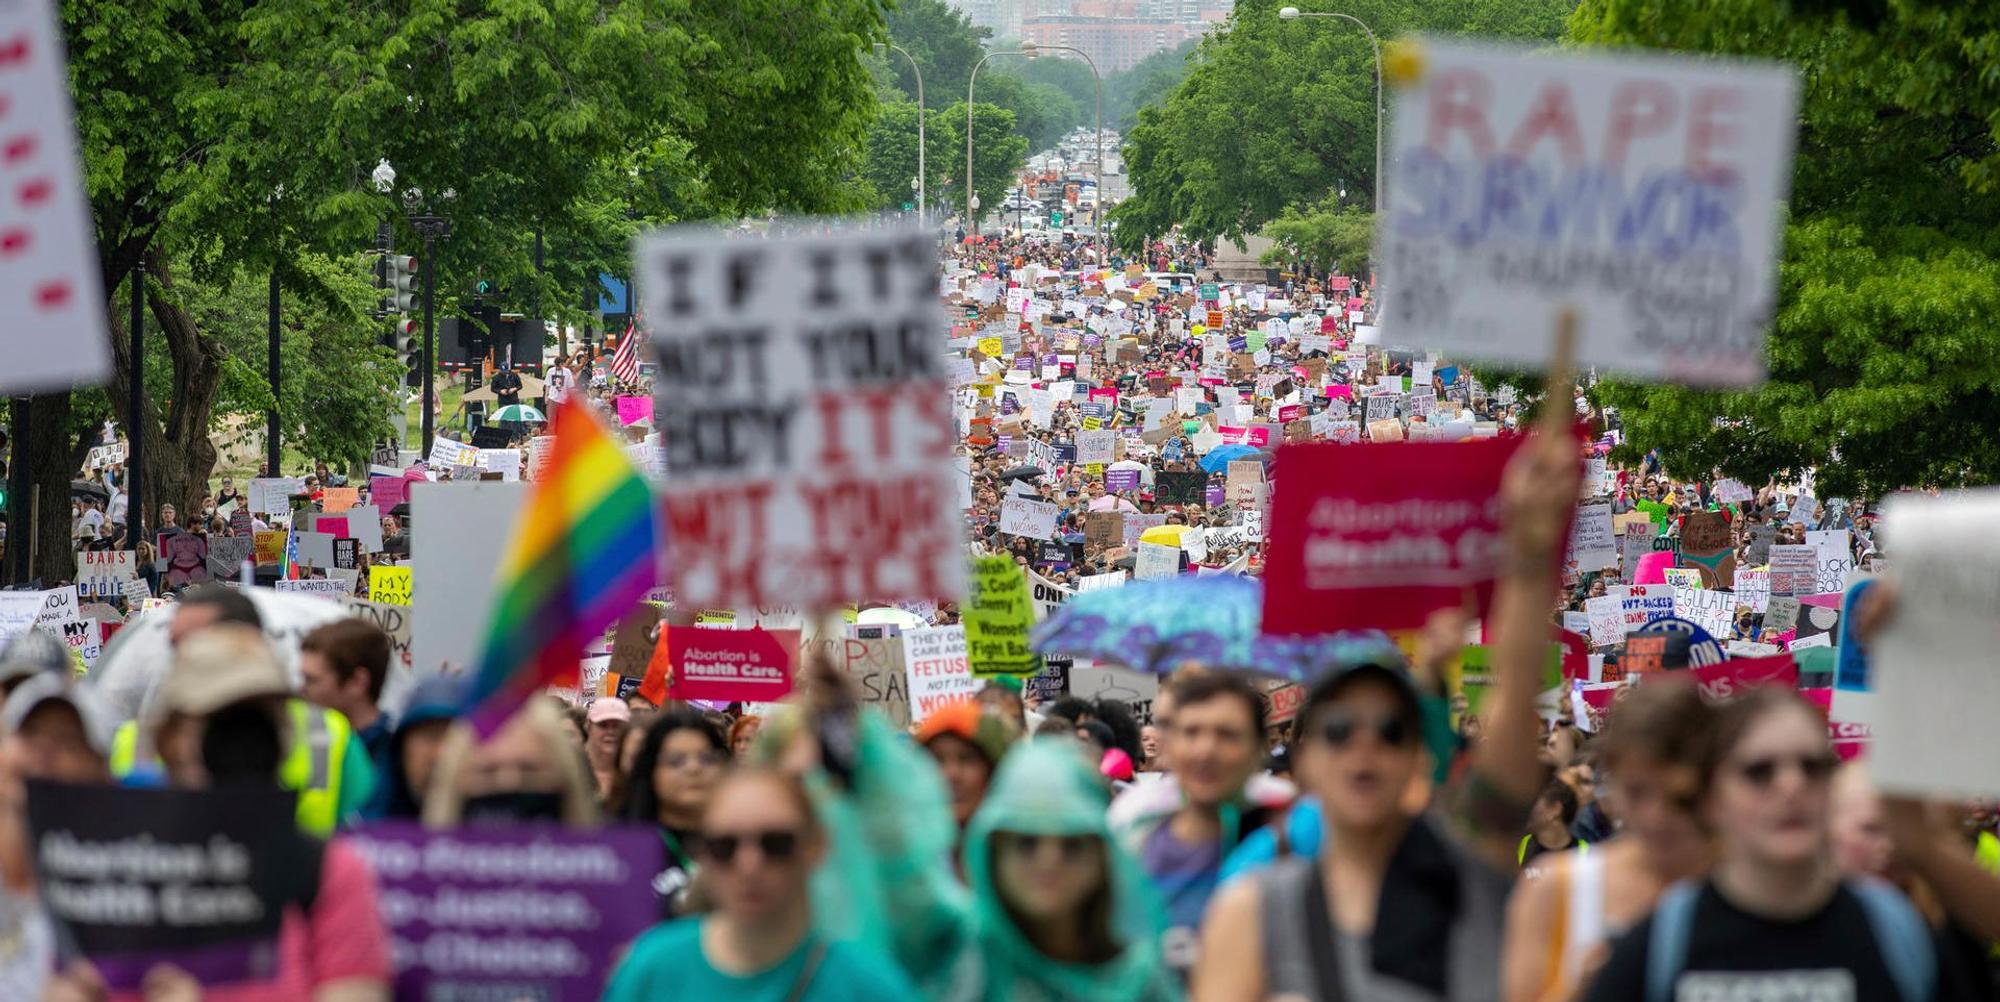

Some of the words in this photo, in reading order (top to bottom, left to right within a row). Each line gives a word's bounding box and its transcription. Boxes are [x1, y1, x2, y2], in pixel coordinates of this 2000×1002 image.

[1010, 520, 1041, 535] WOMB
[1627, 523, 1646, 534] NO
[337, 541, 353, 550] HOW
[1652, 537, 1682, 553] CODIF
[86, 551, 126, 565] BANS
[337, 550, 354, 560] DARE
[1818, 559, 1849, 572] UCK
[1739, 571, 1770, 580] ABORTIO
[80, 582, 124, 595] BODIE
[300, 581, 333, 591] WANTED
[378, 575, 409, 591] MY
[1817, 580, 1843, 593] GOD
[1629, 586, 1647, 596] NO
[373, 591, 412, 606] BODY
[1675, 588, 1735, 612] EGULATE
[349, 602, 404, 633] IND
[1689, 608, 1709, 618] THE
[63, 622, 89, 636] MY
[1591, 616, 1620, 631] WAR
[911, 634, 943, 645] THEY
[946, 632, 965, 642] ON
[684, 648, 745, 662] Abortion
[749, 650, 761, 662] is
[912, 645, 941, 657] CARE
[944, 643, 967, 653] ABO
[684, 662, 737, 676] Health
[740, 663, 783, 677] Care.
[914, 657, 970, 678] FETUS
[862, 673, 909, 702] SA
[927, 679, 950, 690] NOT
